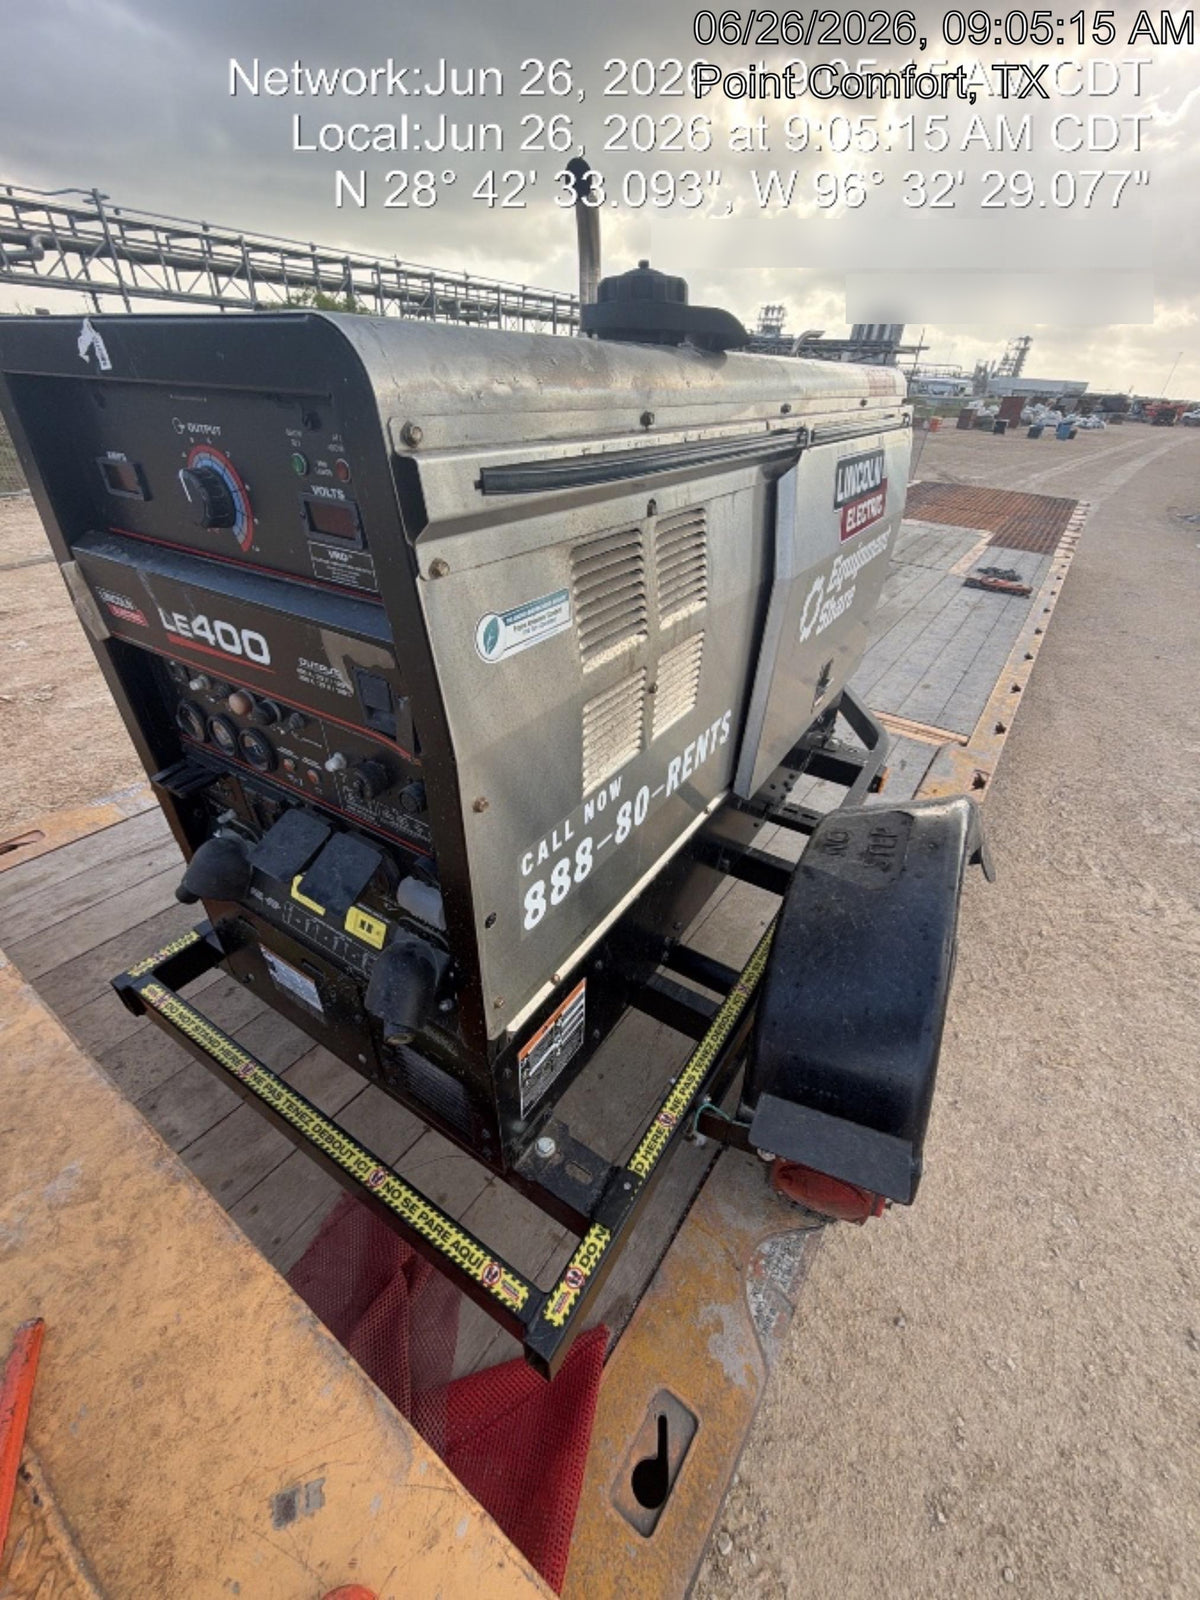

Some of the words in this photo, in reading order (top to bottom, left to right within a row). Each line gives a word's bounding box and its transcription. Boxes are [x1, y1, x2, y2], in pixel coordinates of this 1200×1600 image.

[187, 422, 222, 436] OUTPUT
[311, 484, 346, 501] VOLTS
[837, 456, 883, 502] LINCOLN
[845, 493, 884, 533] ELECTRIC
[158, 607, 271, 665] LE400
[521, 819, 575, 876] CALL
[584, 775, 623, 825] NOW
[523, 708, 732, 931] 888-80-RENTS
[178, 1011, 197, 1028] NOT
[191, 1024, 221, 1049] STAND
[219, 1043, 243, 1067] HERE
[251, 1071, 267, 1086] NE
[263, 1081, 284, 1102] PAS
[282, 1098, 316, 1129] TENEZ
[312, 1123, 356, 1161] DEBOUT
[353, 1157, 373, 1176] ICI
[641, 1126, 666, 1162] HERE
[382, 1181, 404, 1201] NO
[401, 1197, 420, 1215] SE
[417, 1211, 453, 1244] PARE
[578, 1241, 599, 1269] DO
